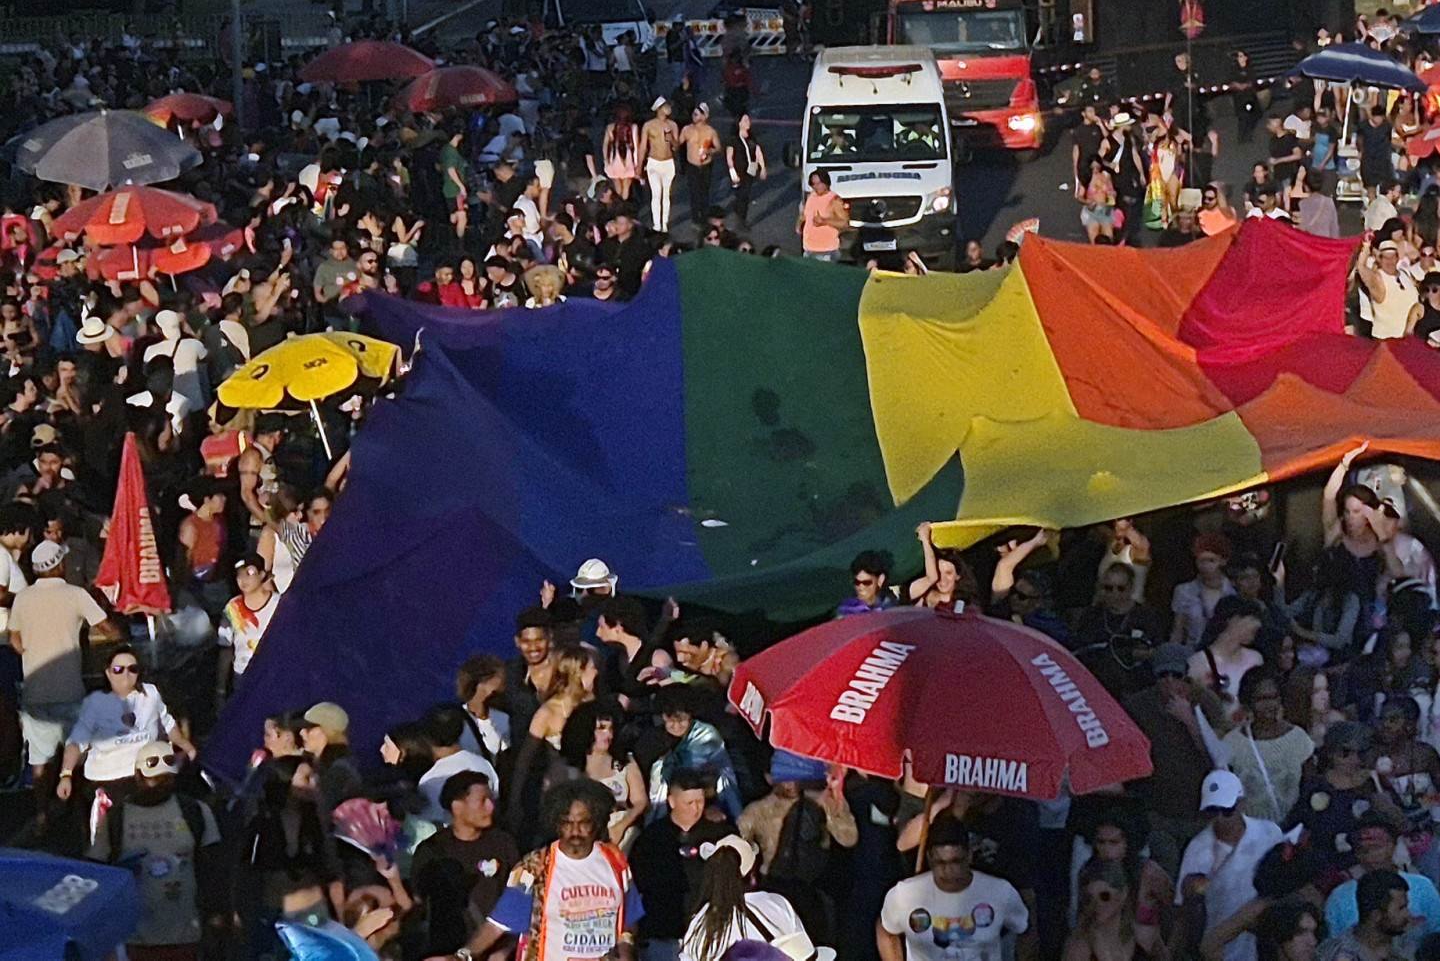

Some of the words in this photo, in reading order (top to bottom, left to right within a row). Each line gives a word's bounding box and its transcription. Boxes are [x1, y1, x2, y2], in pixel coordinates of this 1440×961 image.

[936, 0, 983, 8] MALIBU
[829, 640, 917, 725] BRAHMA
[1030, 653, 1110, 748] BRAHMA
[944, 753, 1028, 793] BRAHMA
